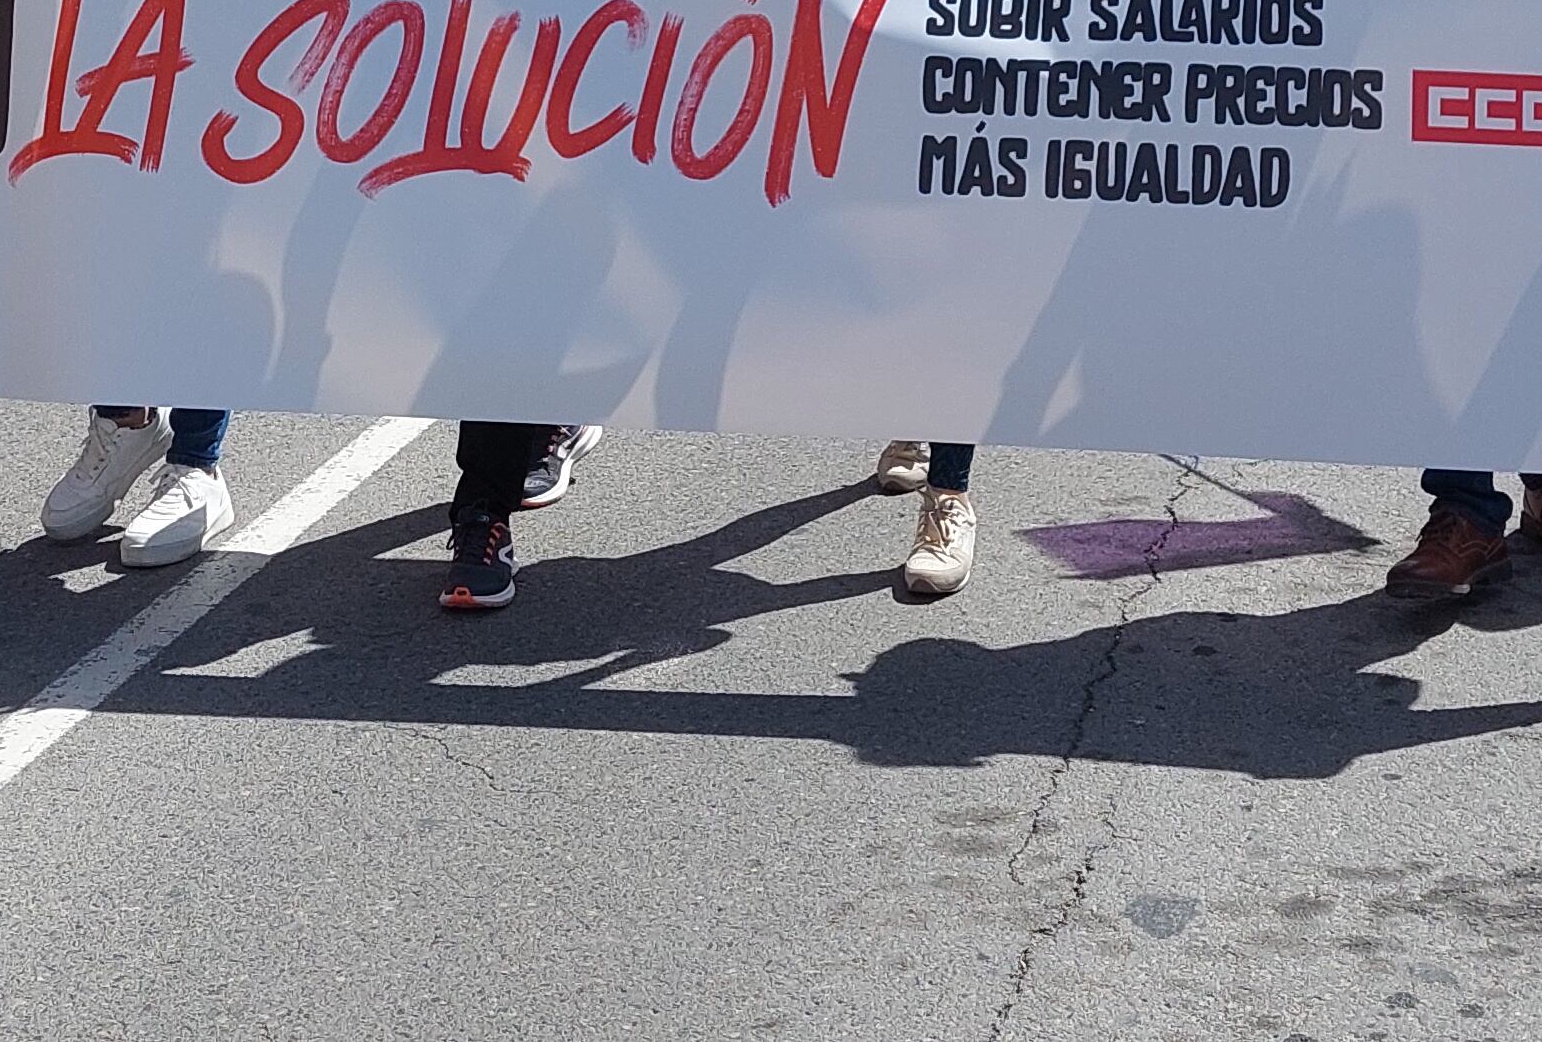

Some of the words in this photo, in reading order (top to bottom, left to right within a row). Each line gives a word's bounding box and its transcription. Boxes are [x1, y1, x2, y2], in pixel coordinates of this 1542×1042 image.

[922, 55, 1172, 123] CONTENER
[1184, 63, 1384, 129] PRECIOS
[917, 120, 1028, 198] MÁS
[1044, 139, 1291, 208] IGUALDAD
